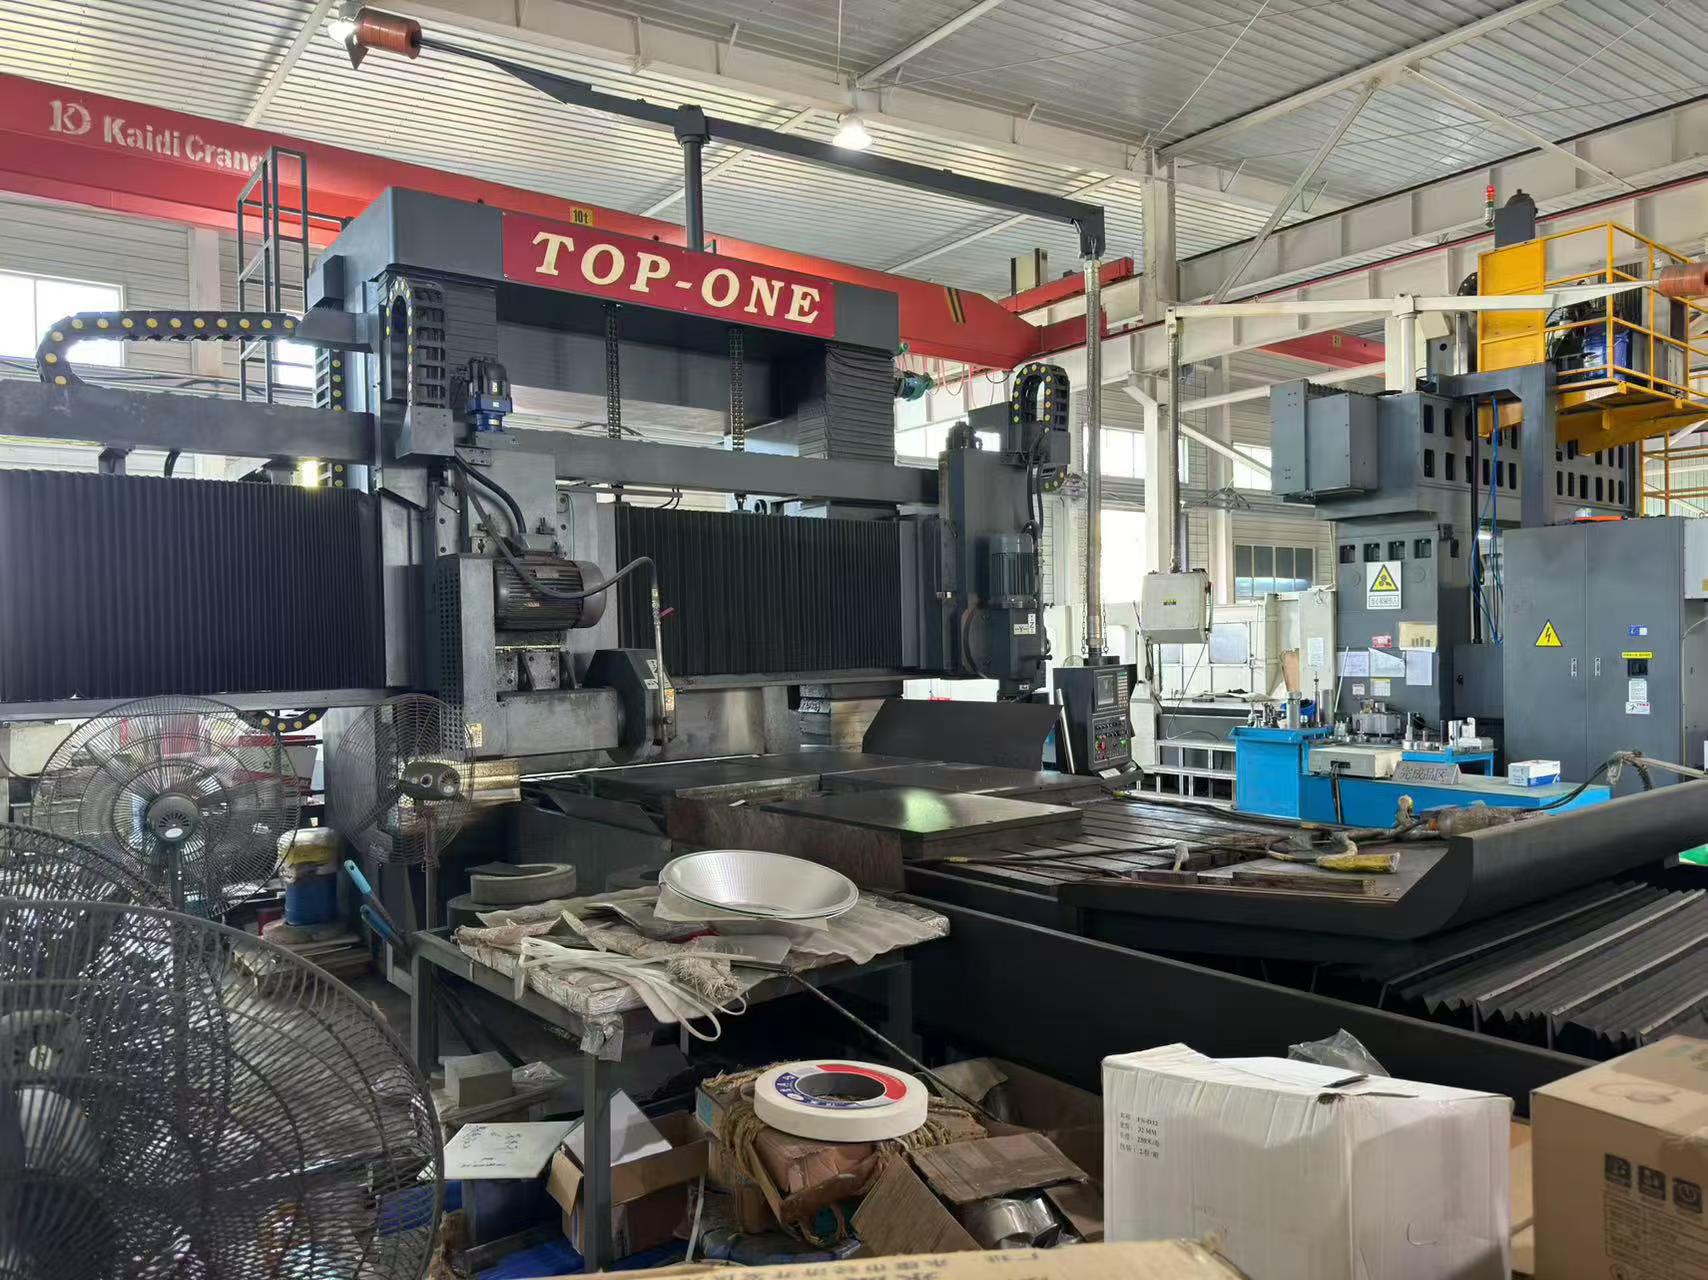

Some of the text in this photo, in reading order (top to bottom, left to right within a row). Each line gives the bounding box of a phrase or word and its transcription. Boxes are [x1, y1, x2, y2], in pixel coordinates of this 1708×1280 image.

[104, 115, 180, 157] Kaidi
[573, 209, 588, 224] 10t
[532, 231, 821, 324] TOP-ONE
